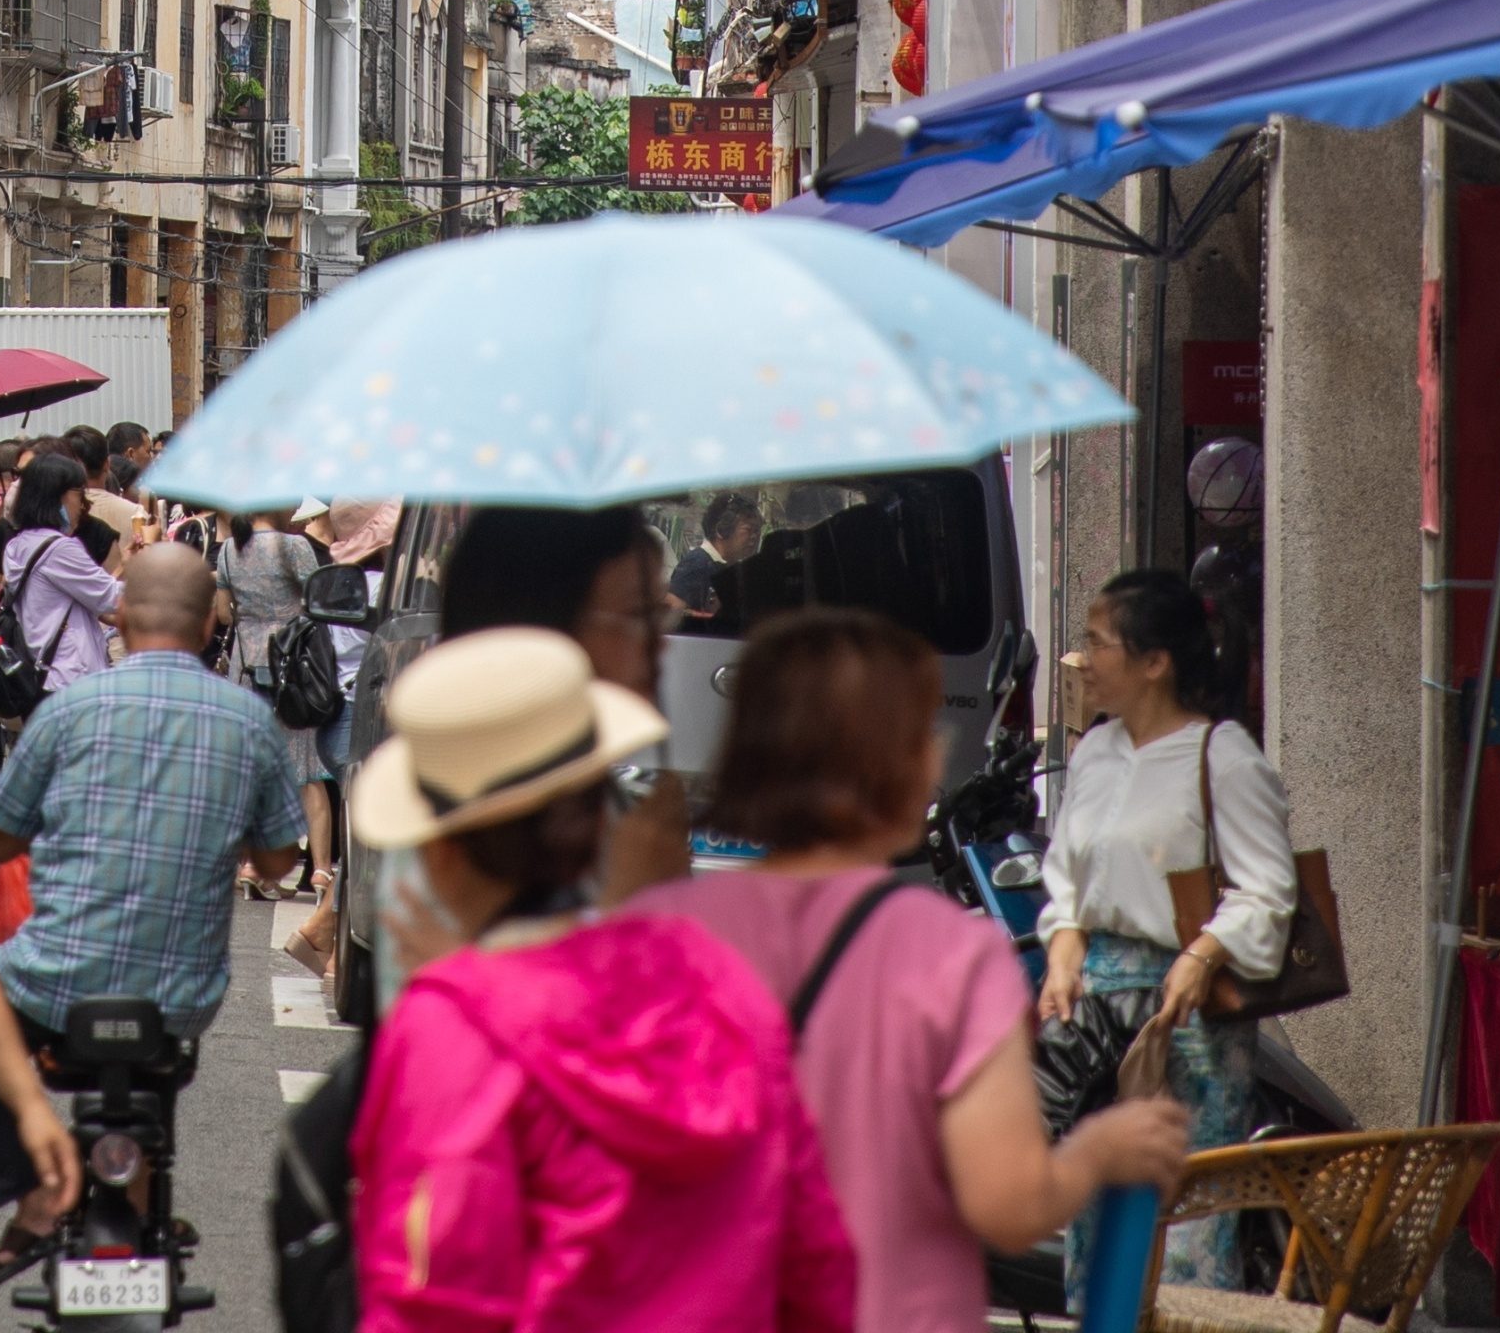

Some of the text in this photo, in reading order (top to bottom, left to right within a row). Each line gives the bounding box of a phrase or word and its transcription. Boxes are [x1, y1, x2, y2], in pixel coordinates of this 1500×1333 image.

[720, 106, 773, 121] 口味王
[66, 1283, 160, 1306] 466233
